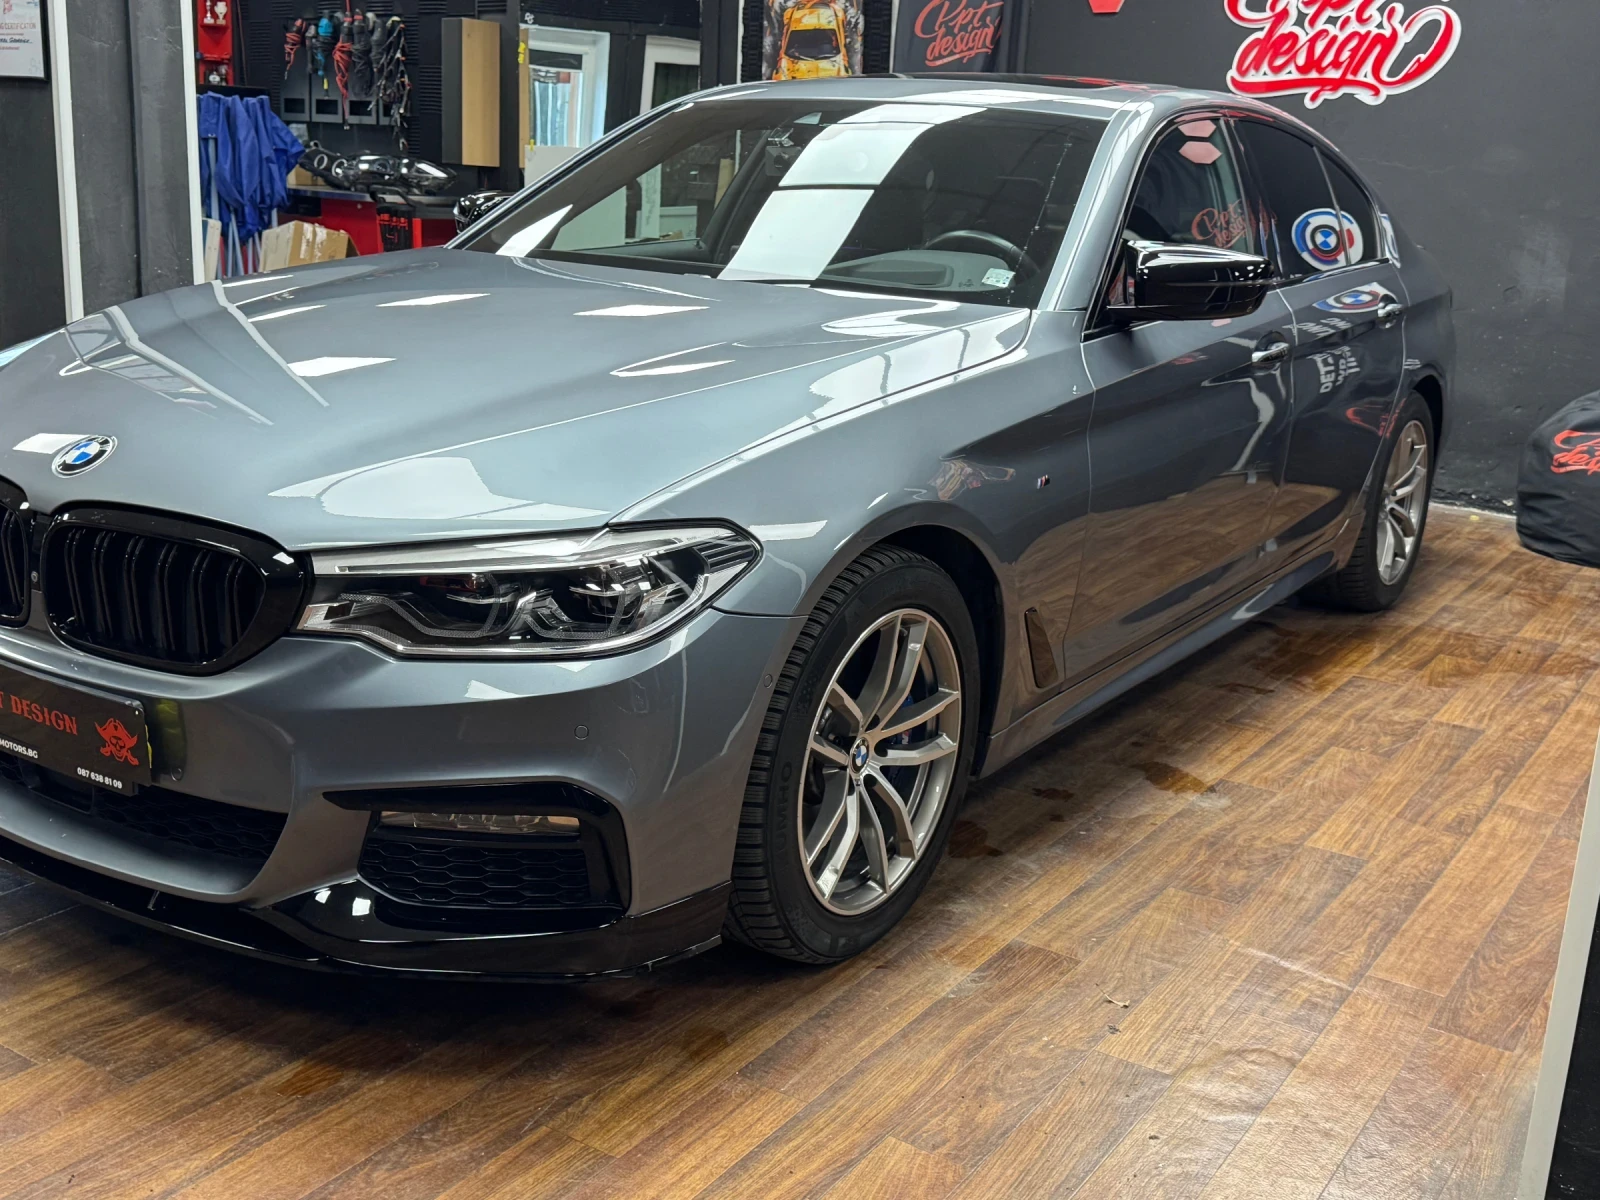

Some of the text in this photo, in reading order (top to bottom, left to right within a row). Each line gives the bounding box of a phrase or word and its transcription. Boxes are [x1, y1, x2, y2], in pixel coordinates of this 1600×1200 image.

[926, 15, 1004, 64] design
[1235, 6, 1453, 104] design
[10, 694, 78, 736] DESIGN
[77, 766, 90, 778] 087
[104, 776, 112, 786] 81
[113, 779, 123, 789] 09
